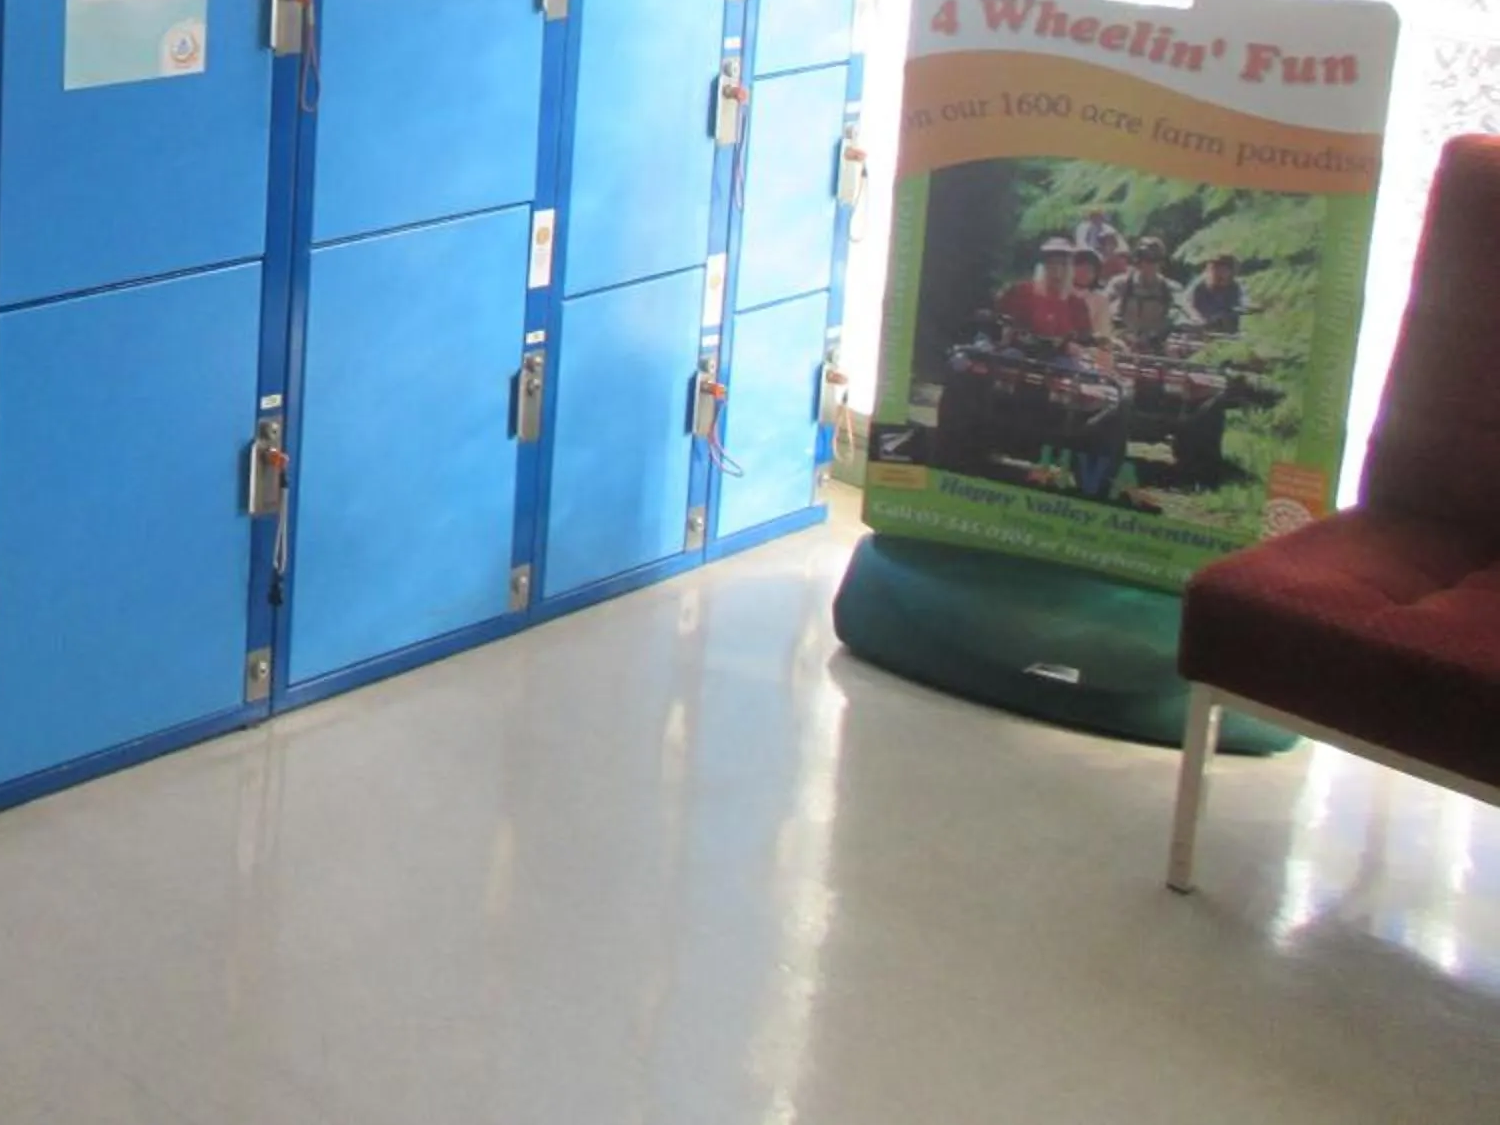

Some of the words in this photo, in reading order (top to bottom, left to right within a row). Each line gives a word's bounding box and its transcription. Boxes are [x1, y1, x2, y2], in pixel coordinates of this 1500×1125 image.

[1240, 42, 1360, 85] Fun
[940, 98, 988, 121] our
[1001, 91, 1072, 118] 1600
[1080, 104, 1143, 134] acre
[1152, 116, 1224, 155] farm
[939, 474, 1016, 506] Happy
